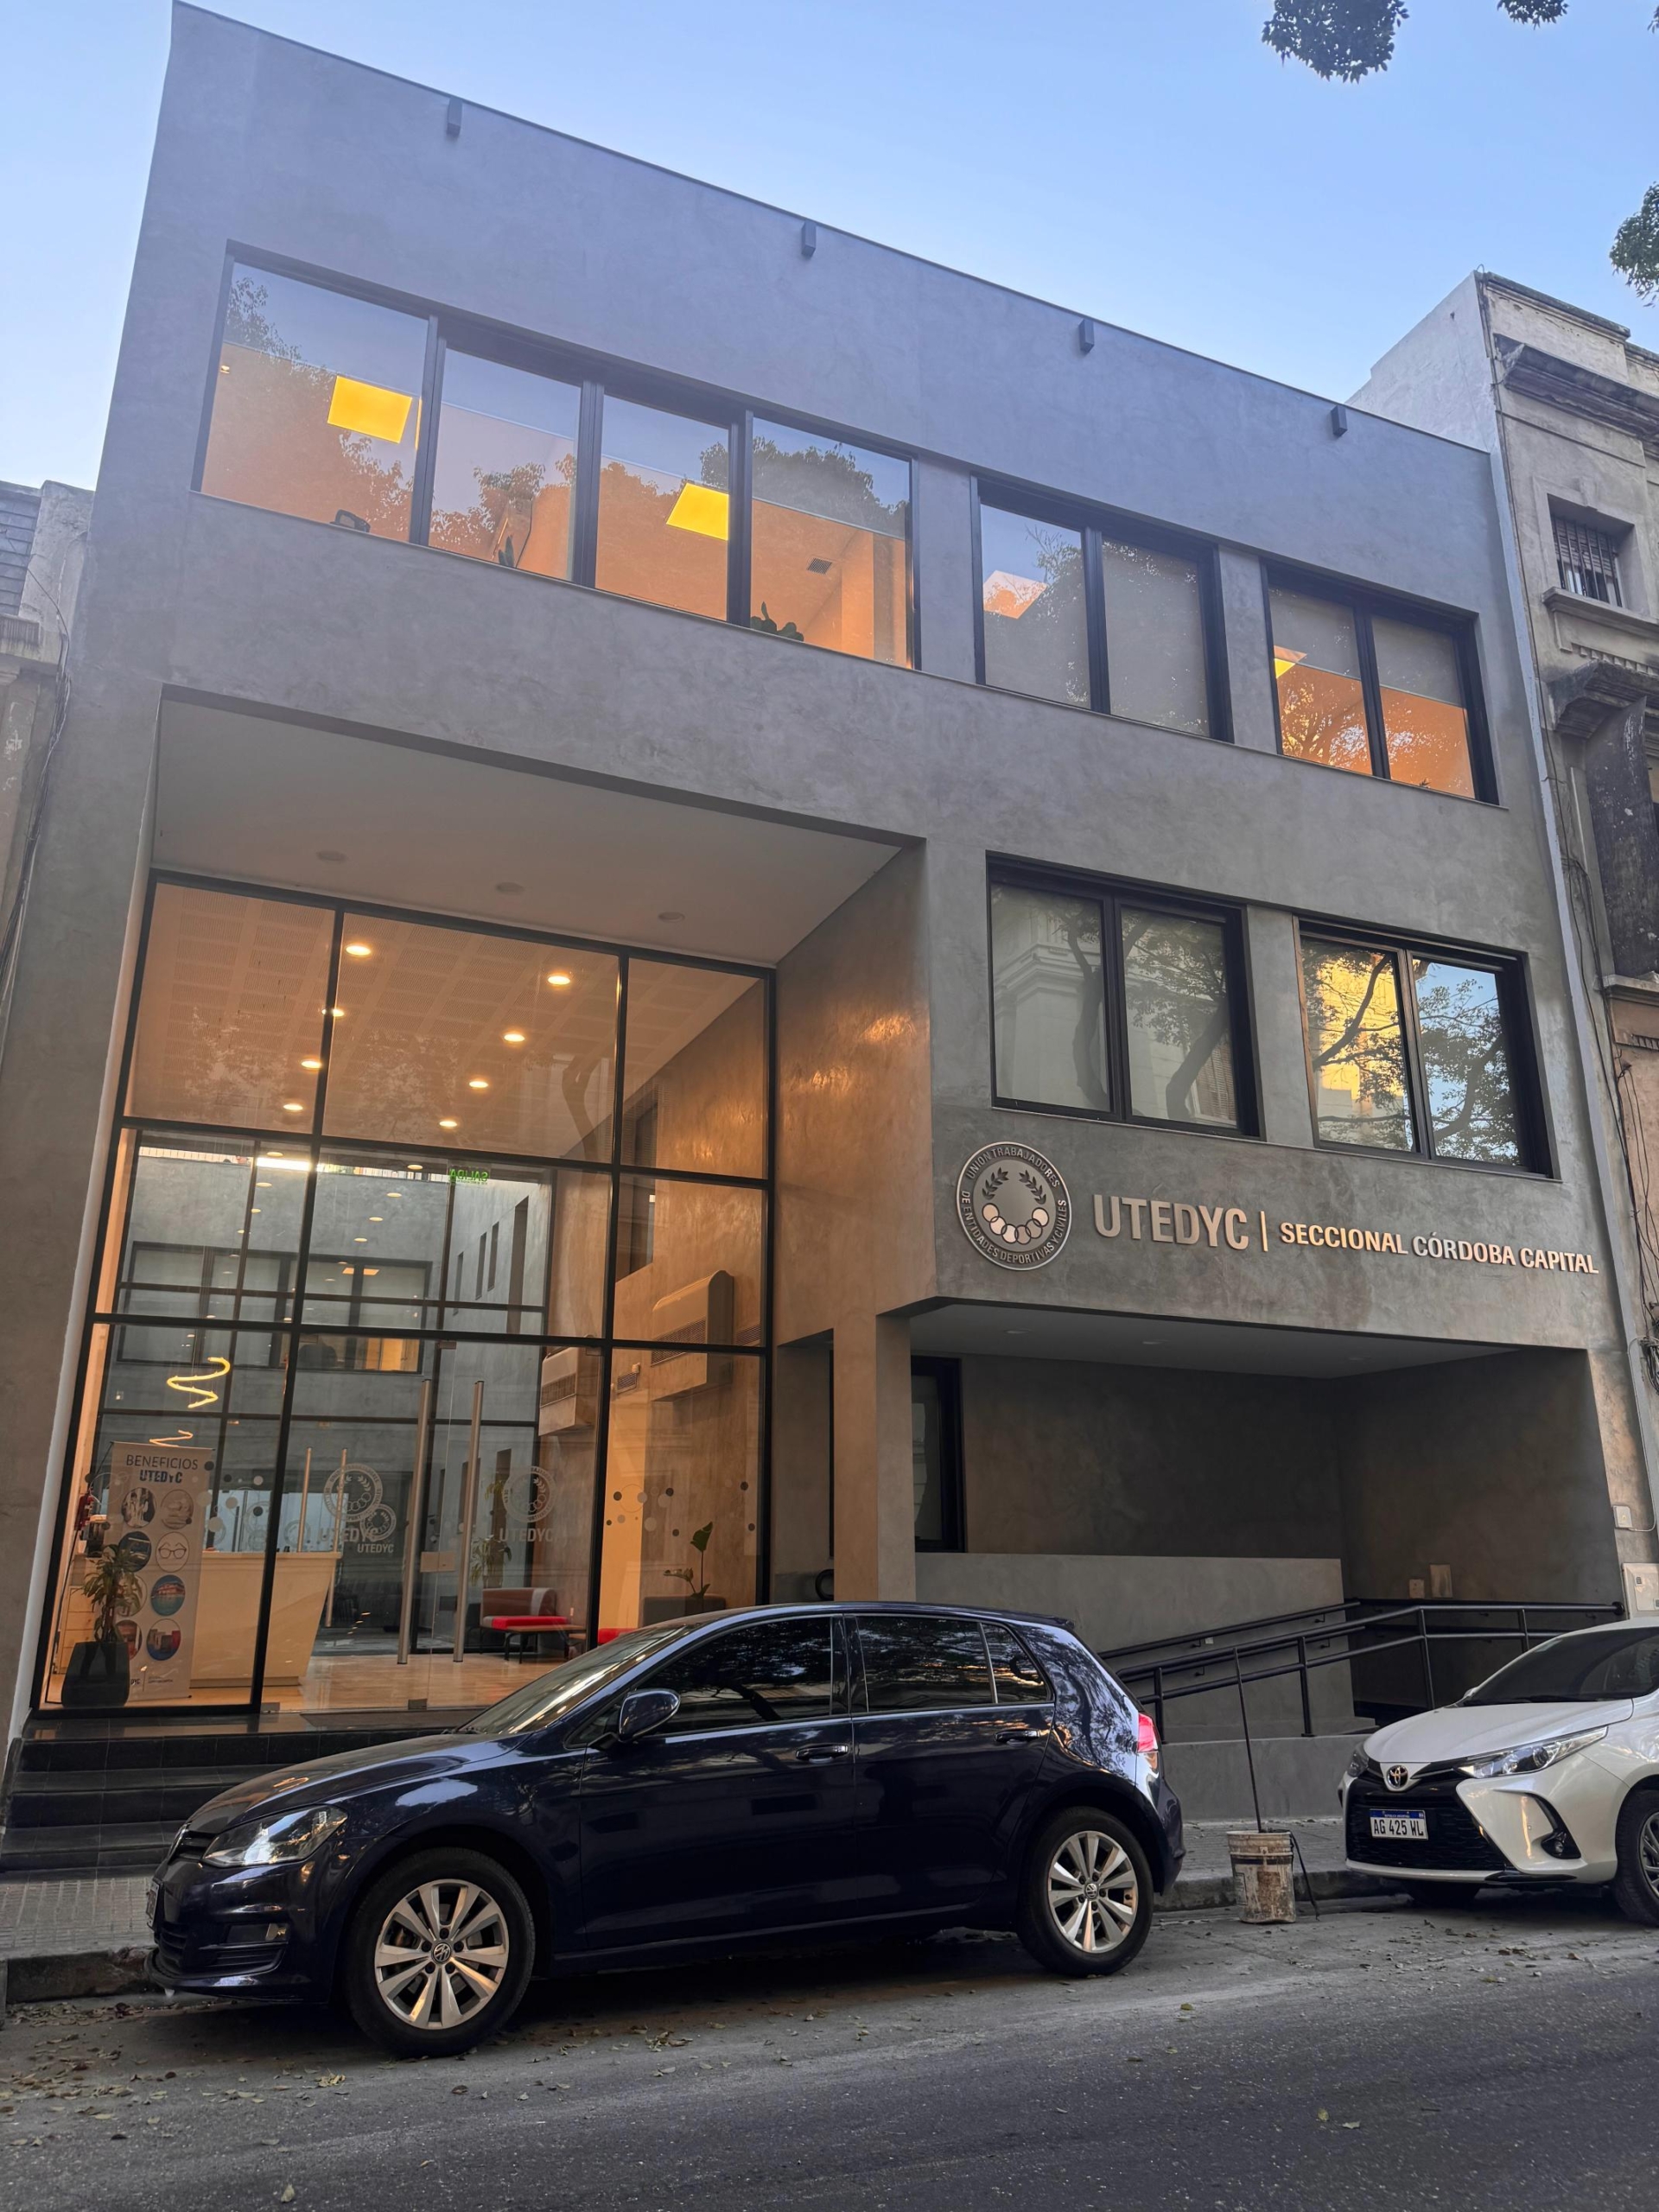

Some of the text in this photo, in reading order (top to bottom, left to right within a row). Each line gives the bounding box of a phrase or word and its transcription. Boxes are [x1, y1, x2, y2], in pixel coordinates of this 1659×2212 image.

[966, 1147, 1060, 1187] UNION TRABAJADORES
[962, 1191, 970, 1204] DE
[1054, 1199, 1067, 1240] CIVILES
[963, 1207, 998, 1257] ENTIDADES
[1093, 1194, 1599, 1274] UTEDYC SECCIONAL CÓRDOBA CAPITAL
[1000, 1242, 1054, 1264] DEPORTIVAS
[126, 1454, 198, 1470] BENEFICIOS
[357, 1543, 394, 1554] UTEDYC
[1374, 1819, 1385, 1834] AG
[1389, 1820, 1408, 1835] 425
